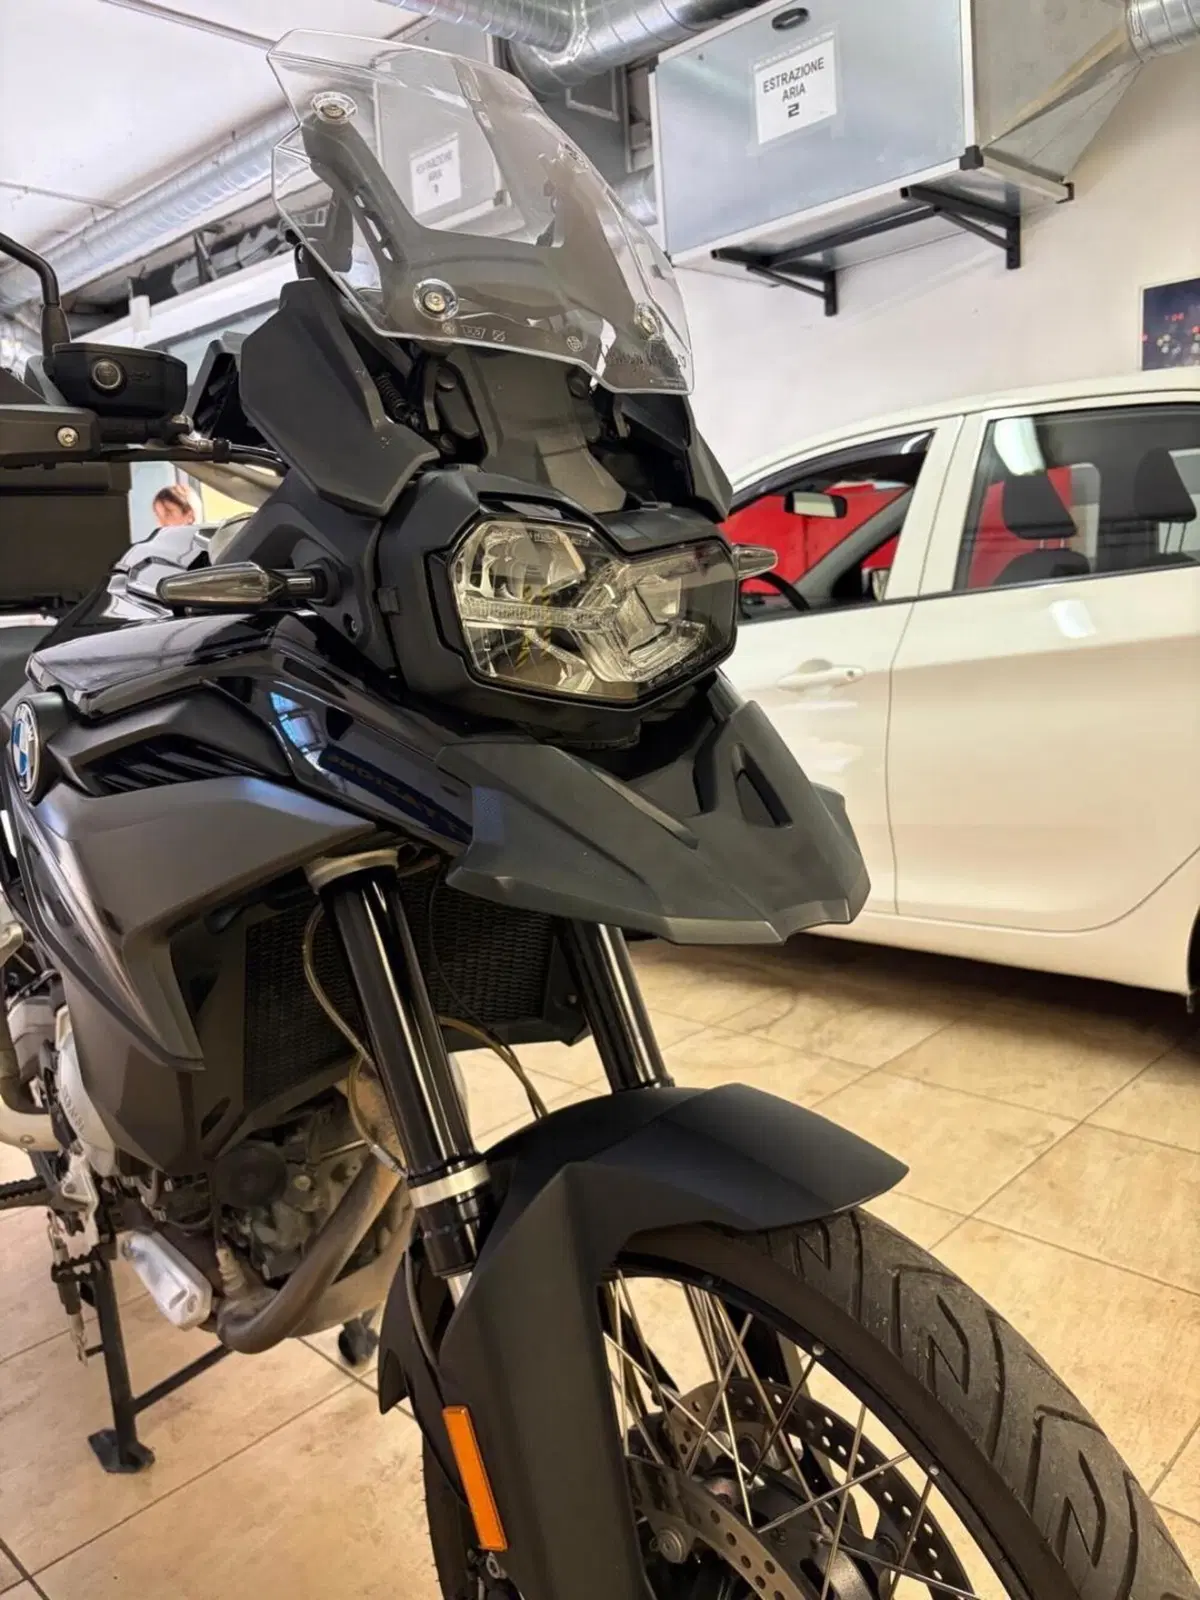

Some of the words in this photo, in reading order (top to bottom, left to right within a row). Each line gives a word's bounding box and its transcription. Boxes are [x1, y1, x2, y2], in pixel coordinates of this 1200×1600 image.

[763, 57, 825, 93] ESTRAZIONE
[782, 83, 806, 102] ARIA
[788, 102, 800, 118] 2
